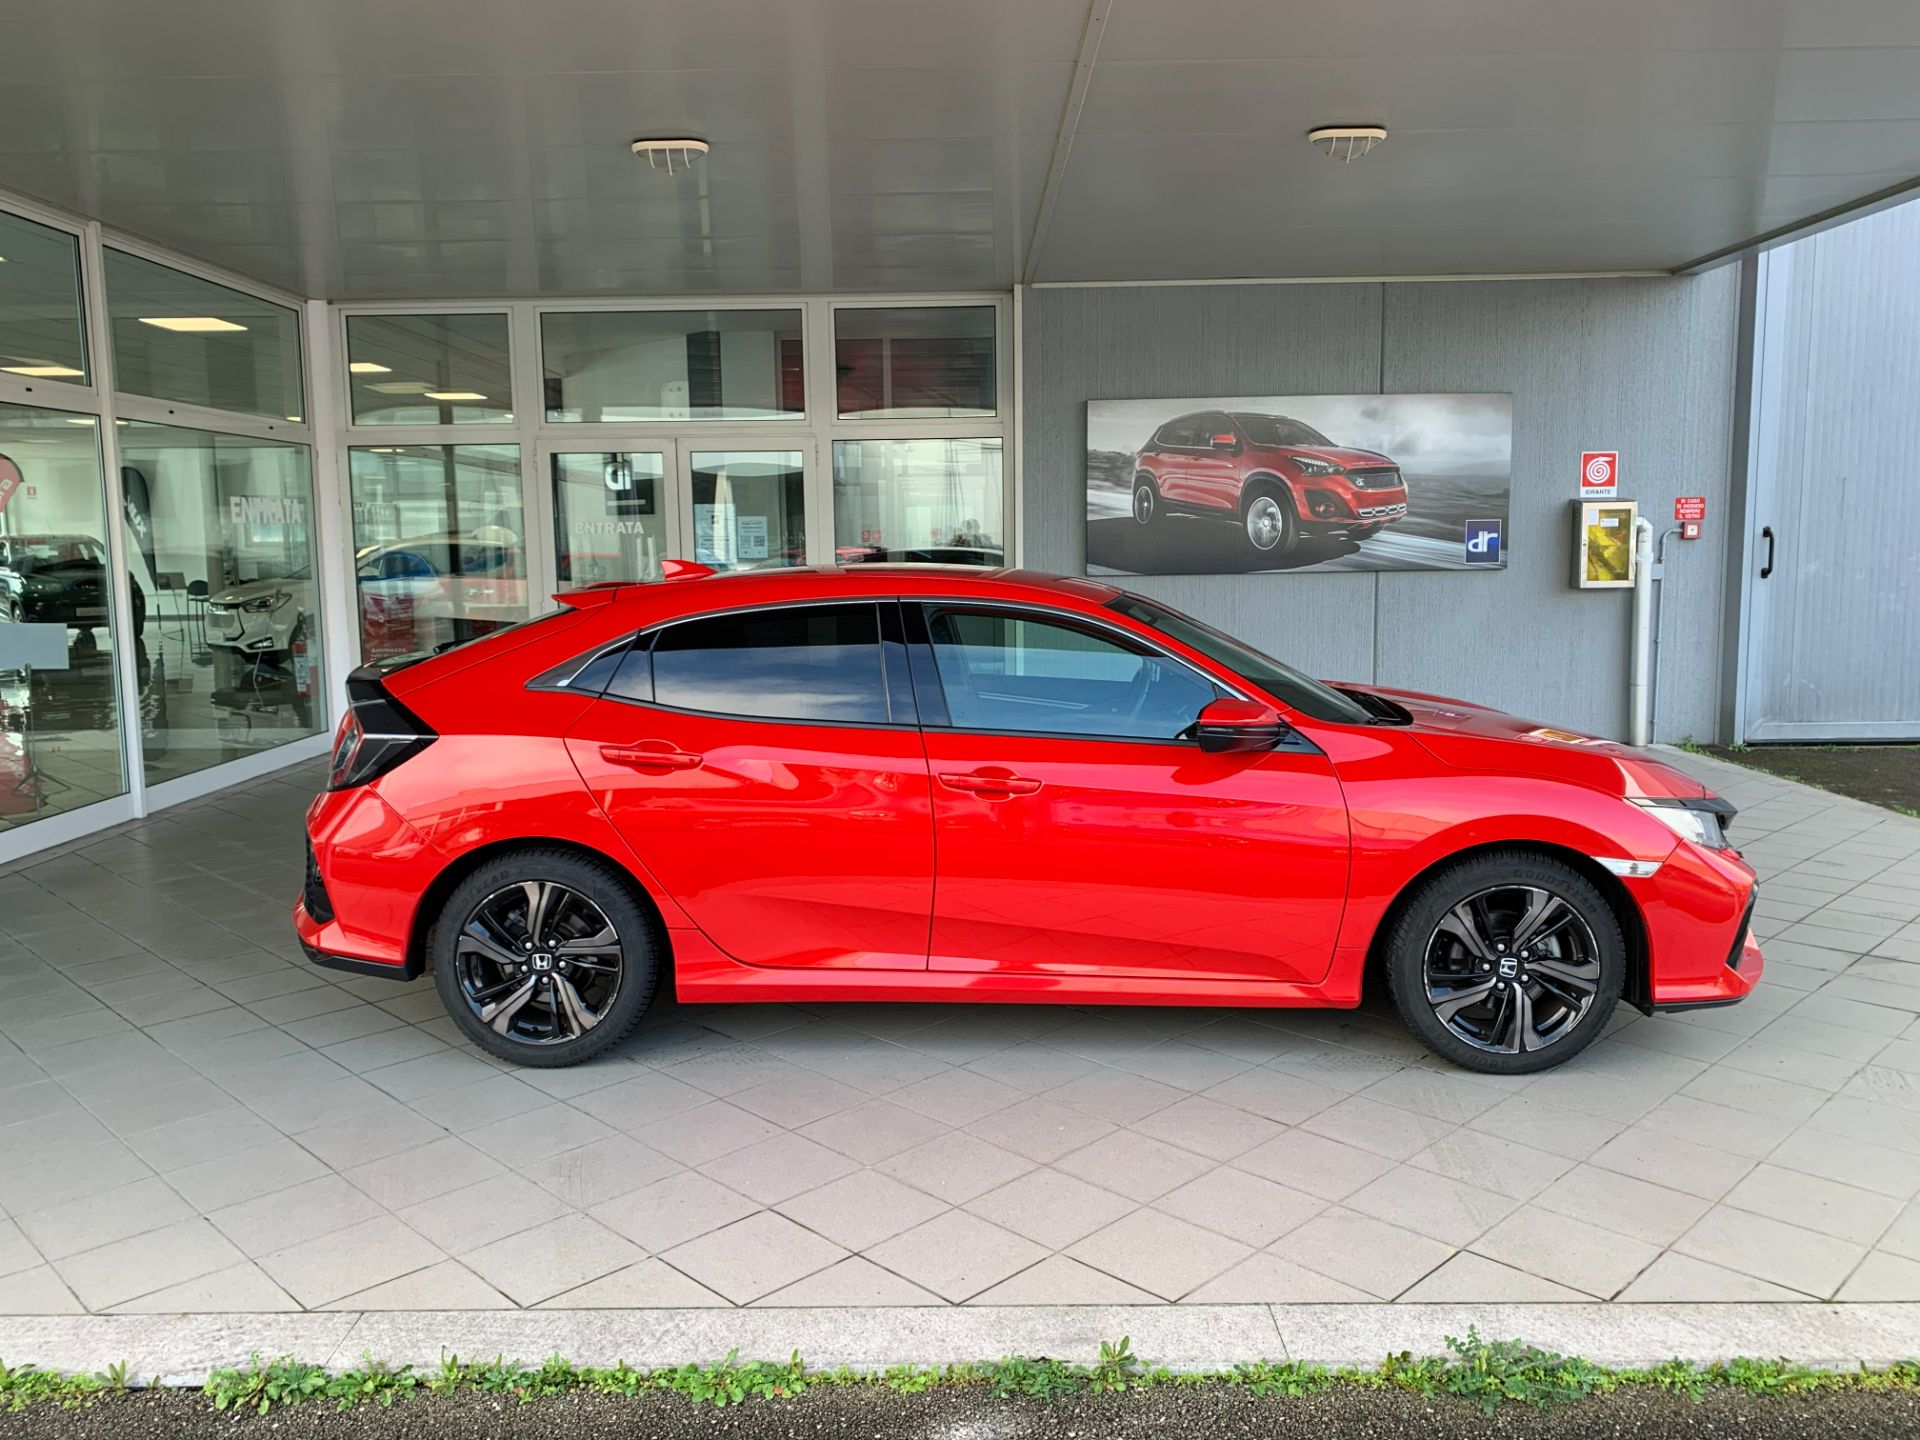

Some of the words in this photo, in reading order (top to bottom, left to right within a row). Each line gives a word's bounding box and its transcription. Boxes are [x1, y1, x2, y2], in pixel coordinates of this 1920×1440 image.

[230, 496, 301, 524] ENTRATA
[575, 521, 644, 534] ENTRATA
[1468, 531, 1498, 552] dr
